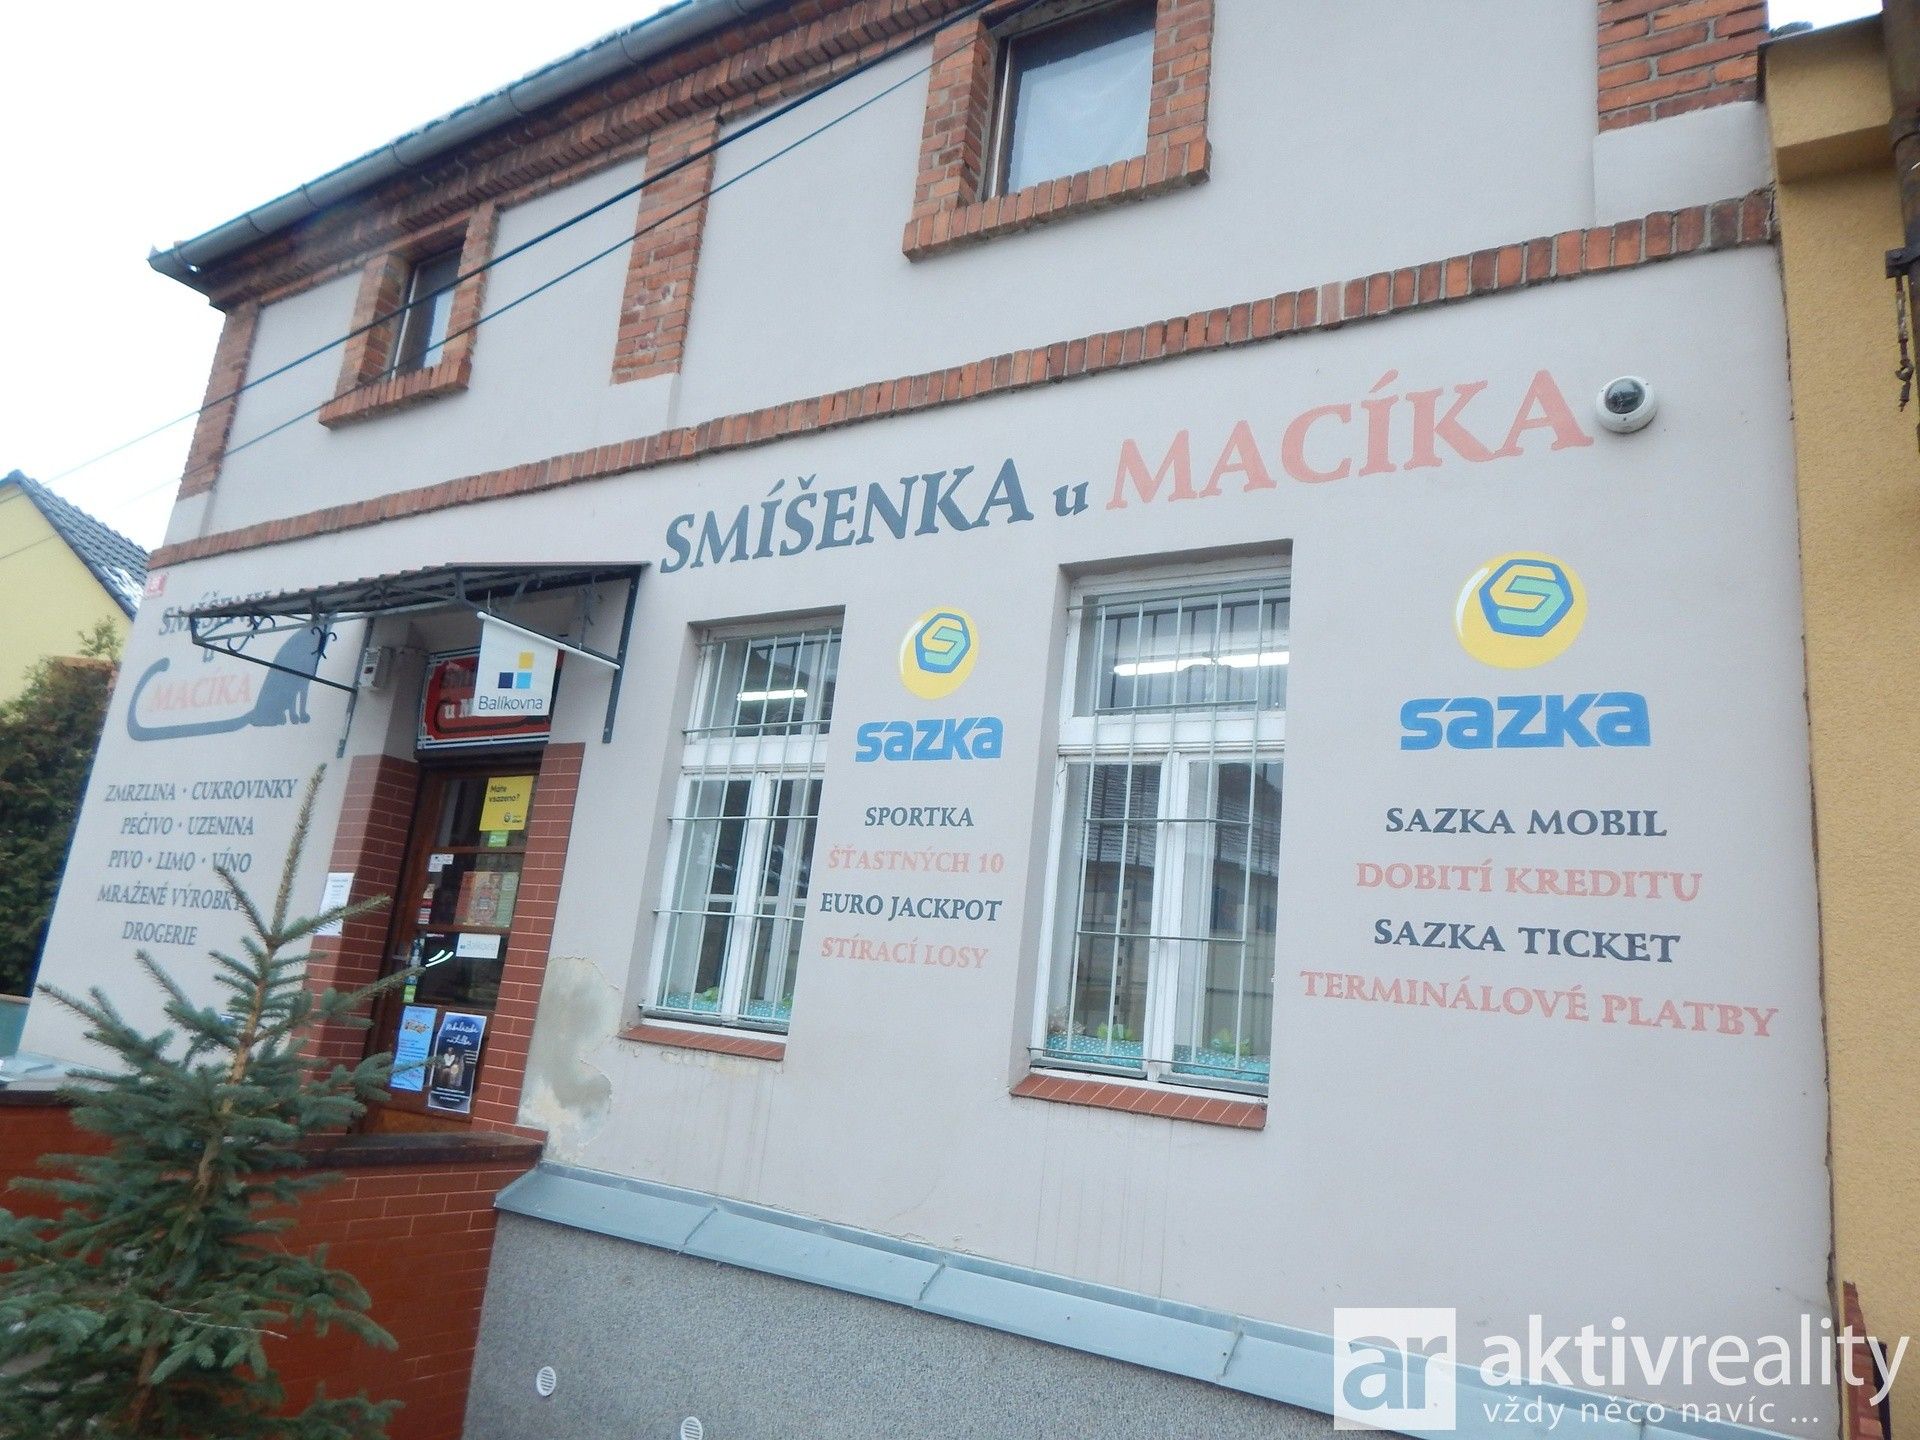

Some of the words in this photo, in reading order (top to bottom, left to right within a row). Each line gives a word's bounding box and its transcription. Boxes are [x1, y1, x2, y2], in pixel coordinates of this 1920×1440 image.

[660, 457, 1034, 573] SMÍŠENKA
[1052, 481, 1089, 517] u
[1106, 369, 1594, 510] MACÍKA
[478, 695, 543, 710] Balíkovna
[104, 784, 176, 802] ZMRZLINA
[191, 779, 298, 800] CUKROVINKY
[120, 812, 173, 835] PEČIVO
[187, 816, 254, 836] UZENINA
[864, 806, 975, 828] SPORTKA
[1385, 808, 1517, 835] SAZKA
[1527, 809, 1668, 837] MOBIL
[107, 850, 143, 869] PIVO
[156, 852, 196, 871] LIMO
[212, 847, 252, 873] VÍNO
[828, 844, 971, 874] ŠŤASTNÝCH
[978, 852, 1005, 874] 10
[97, 881, 169, 906] MRAŽENÉ
[1356, 859, 1493, 893] DOBITÍ
[1504, 866, 1703, 902] KREDITU
[819, 893, 884, 916] EURO
[888, 896, 1003, 922] JACKPOT
[122, 920, 198, 946] DROGERIE
[1373, 919, 1506, 953] SAZKA
[1518, 926, 1682, 964] TICKET
[820, 933, 919, 965] STÍRACÍ
[923, 944, 989, 970] LOSY
[1299, 969, 1590, 1022] TERMINÁLOVÉ
[1601, 994, 1780, 1038] PLATBY
